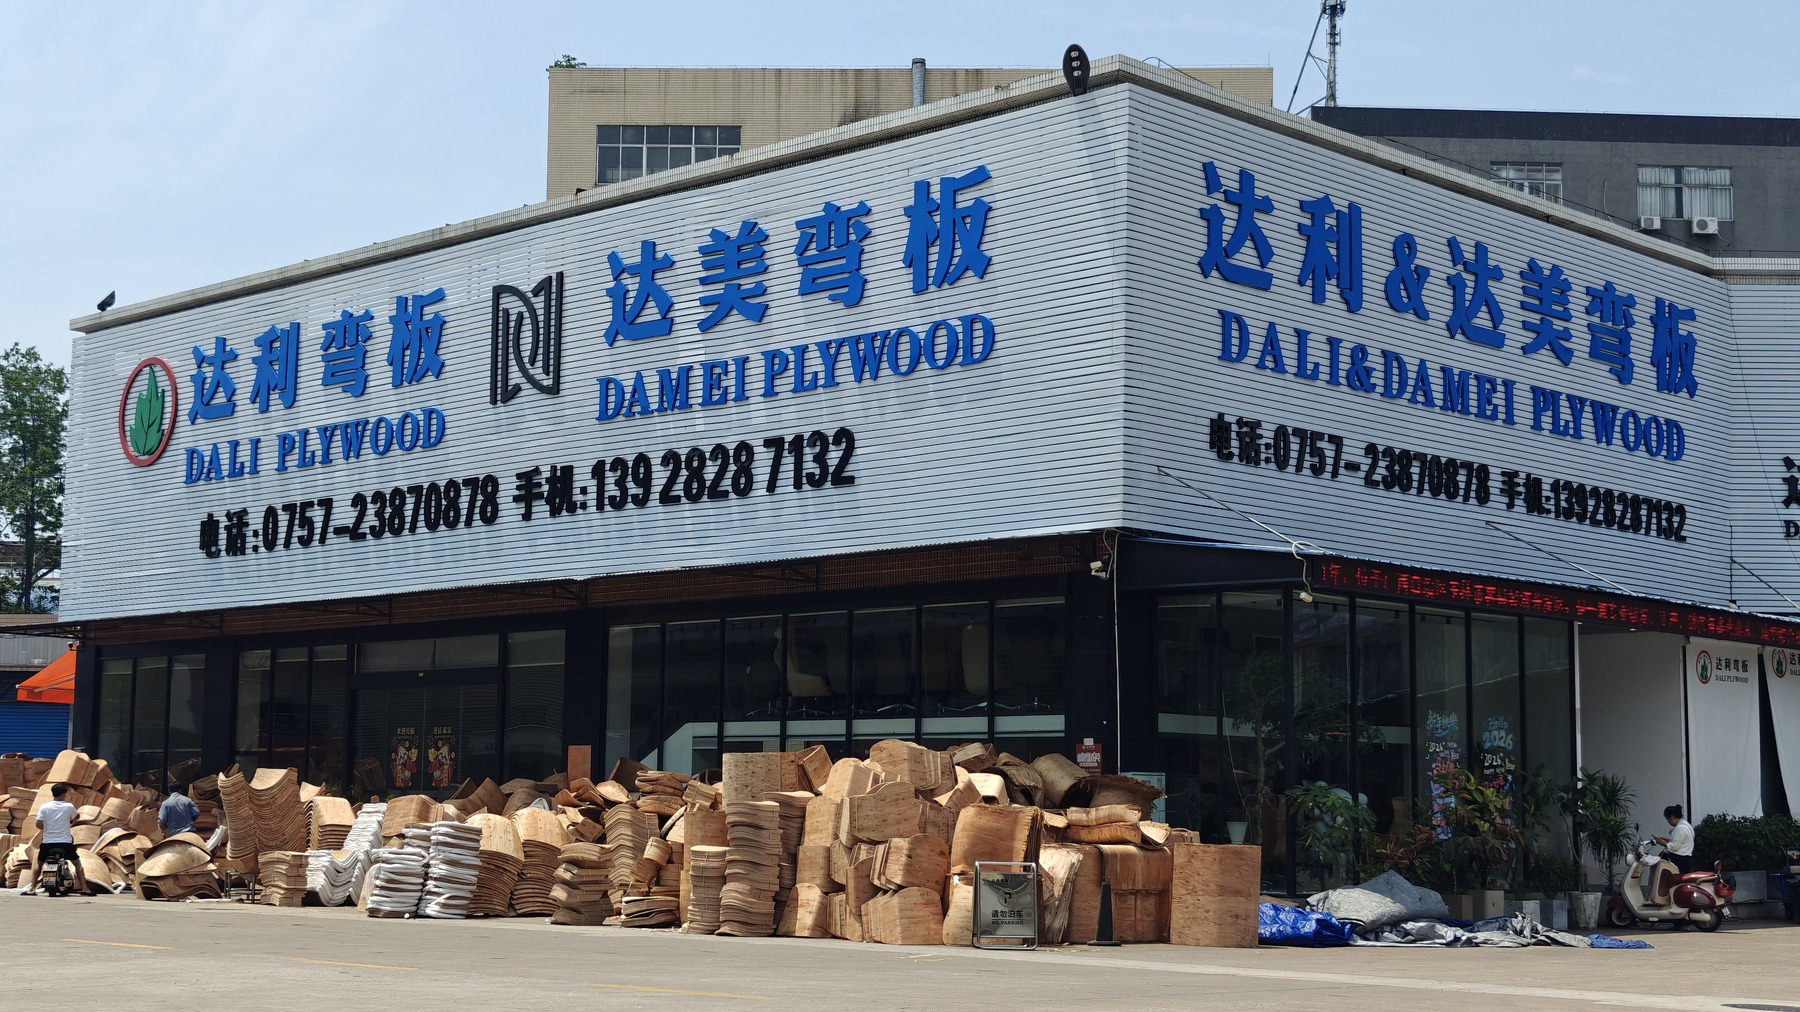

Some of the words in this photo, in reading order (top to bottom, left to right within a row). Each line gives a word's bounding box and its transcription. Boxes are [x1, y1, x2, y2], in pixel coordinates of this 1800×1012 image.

[602, 165, 993, 347] 达美弯板
[1199, 161, 1699, 398] 达利&达美弯板
[187, 287, 447, 425] 达利弯板
[595, 355, 749, 422] DAMEI
[760, 313, 996, 398] PLYWOOD
[1217, 309, 1517, 426] DALI&DAMEI
[1530, 385, 1686, 462] PLYWOOD
[183, 437, 260, 485] DALI
[274, 407, 446, 472] PLYWOOD
[1715, 656, 1749, 673] 达利弯板
[1726, 674, 1749, 684] PLYWOOD
[1482, 730, 1513, 750] 2026
[991, 909, 1024, 919] 请勿泊车
